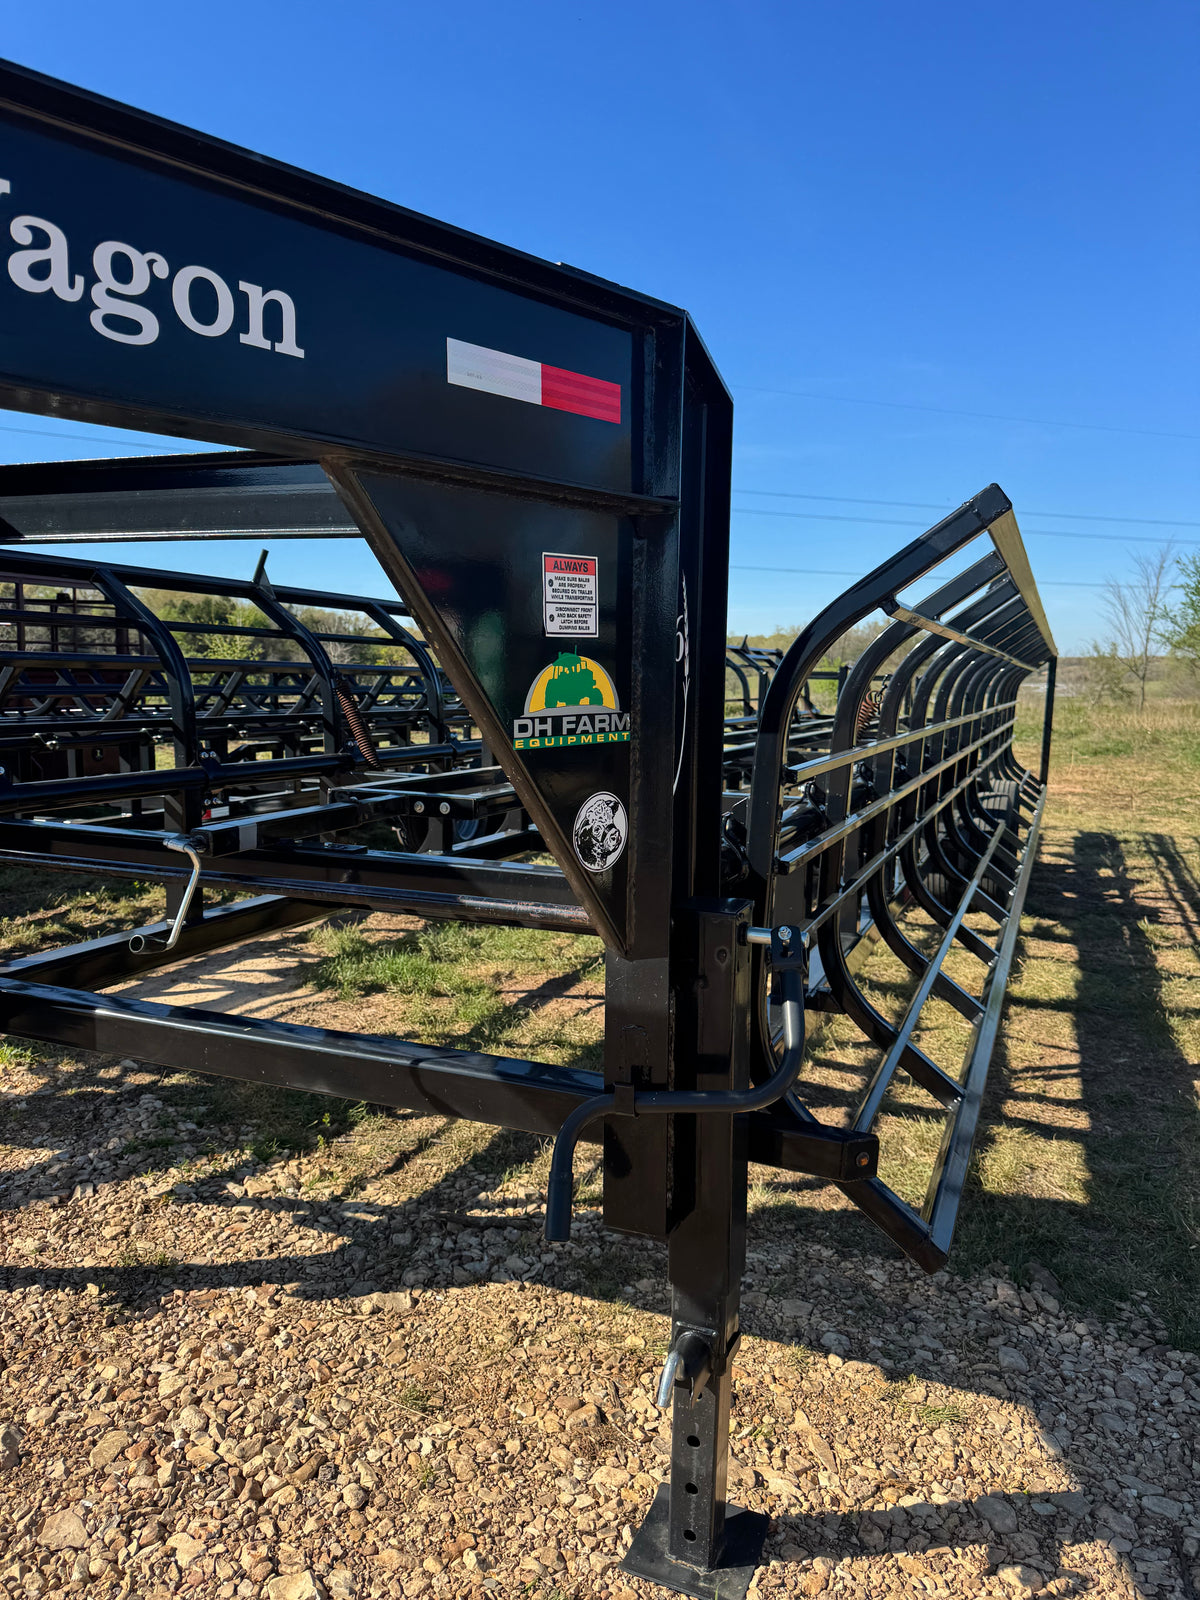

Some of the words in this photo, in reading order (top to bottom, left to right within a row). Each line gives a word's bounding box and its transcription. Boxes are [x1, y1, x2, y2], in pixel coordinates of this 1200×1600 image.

[0, 178, 305, 359] agon
[553, 560, 588, 573] ALWAYS
[513, 717, 552, 739] DH
[562, 712, 631, 735] FARM
[514, 732, 630, 749] EQUIPMENT
